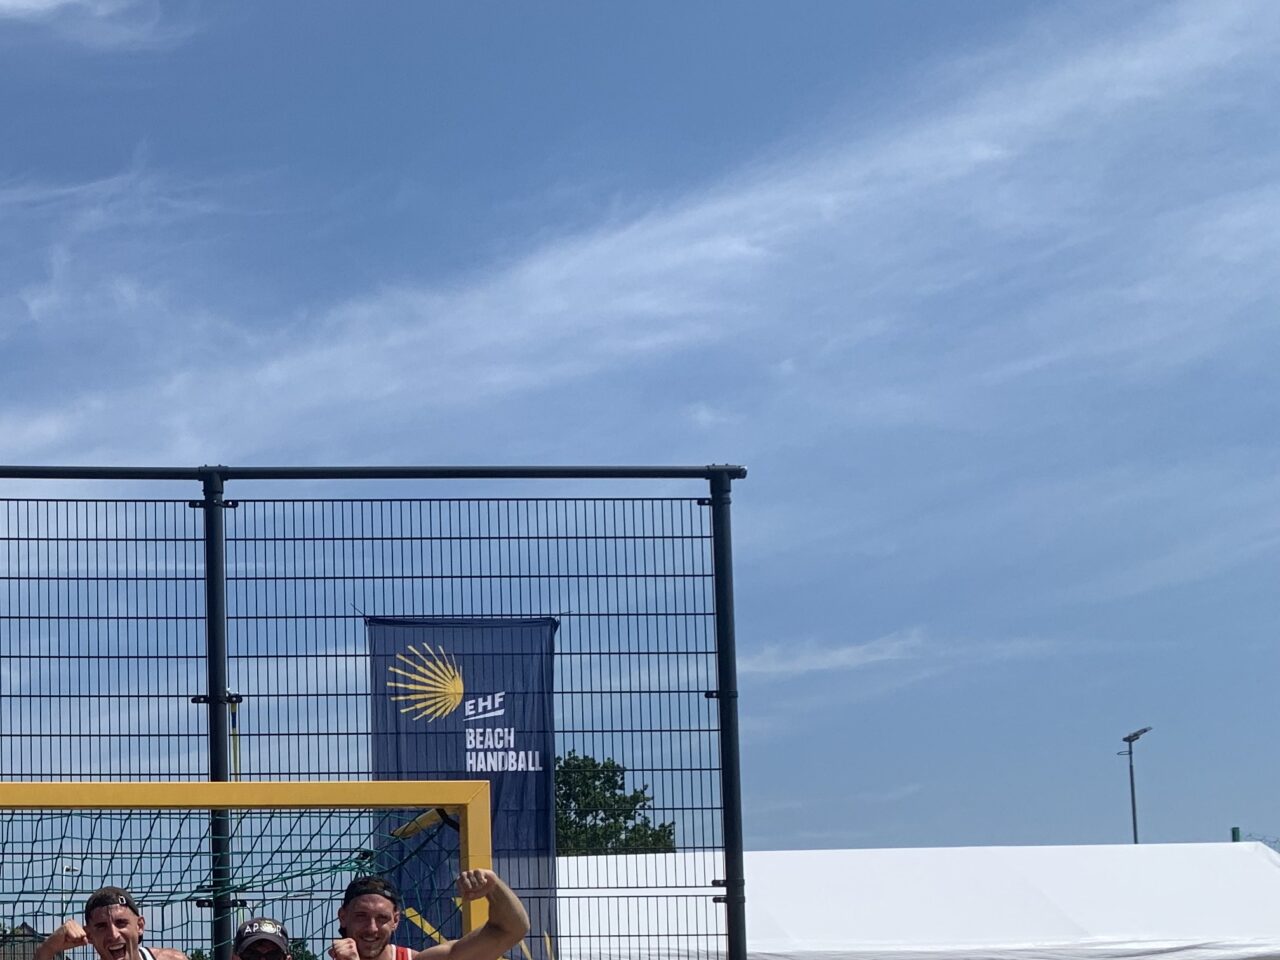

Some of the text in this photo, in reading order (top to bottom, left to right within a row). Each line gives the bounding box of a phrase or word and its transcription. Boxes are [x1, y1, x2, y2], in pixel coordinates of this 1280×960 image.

[465, 691, 505, 716] EHF
[466, 728, 515, 749] BEACH
[466, 751, 543, 772] HANDBALL
